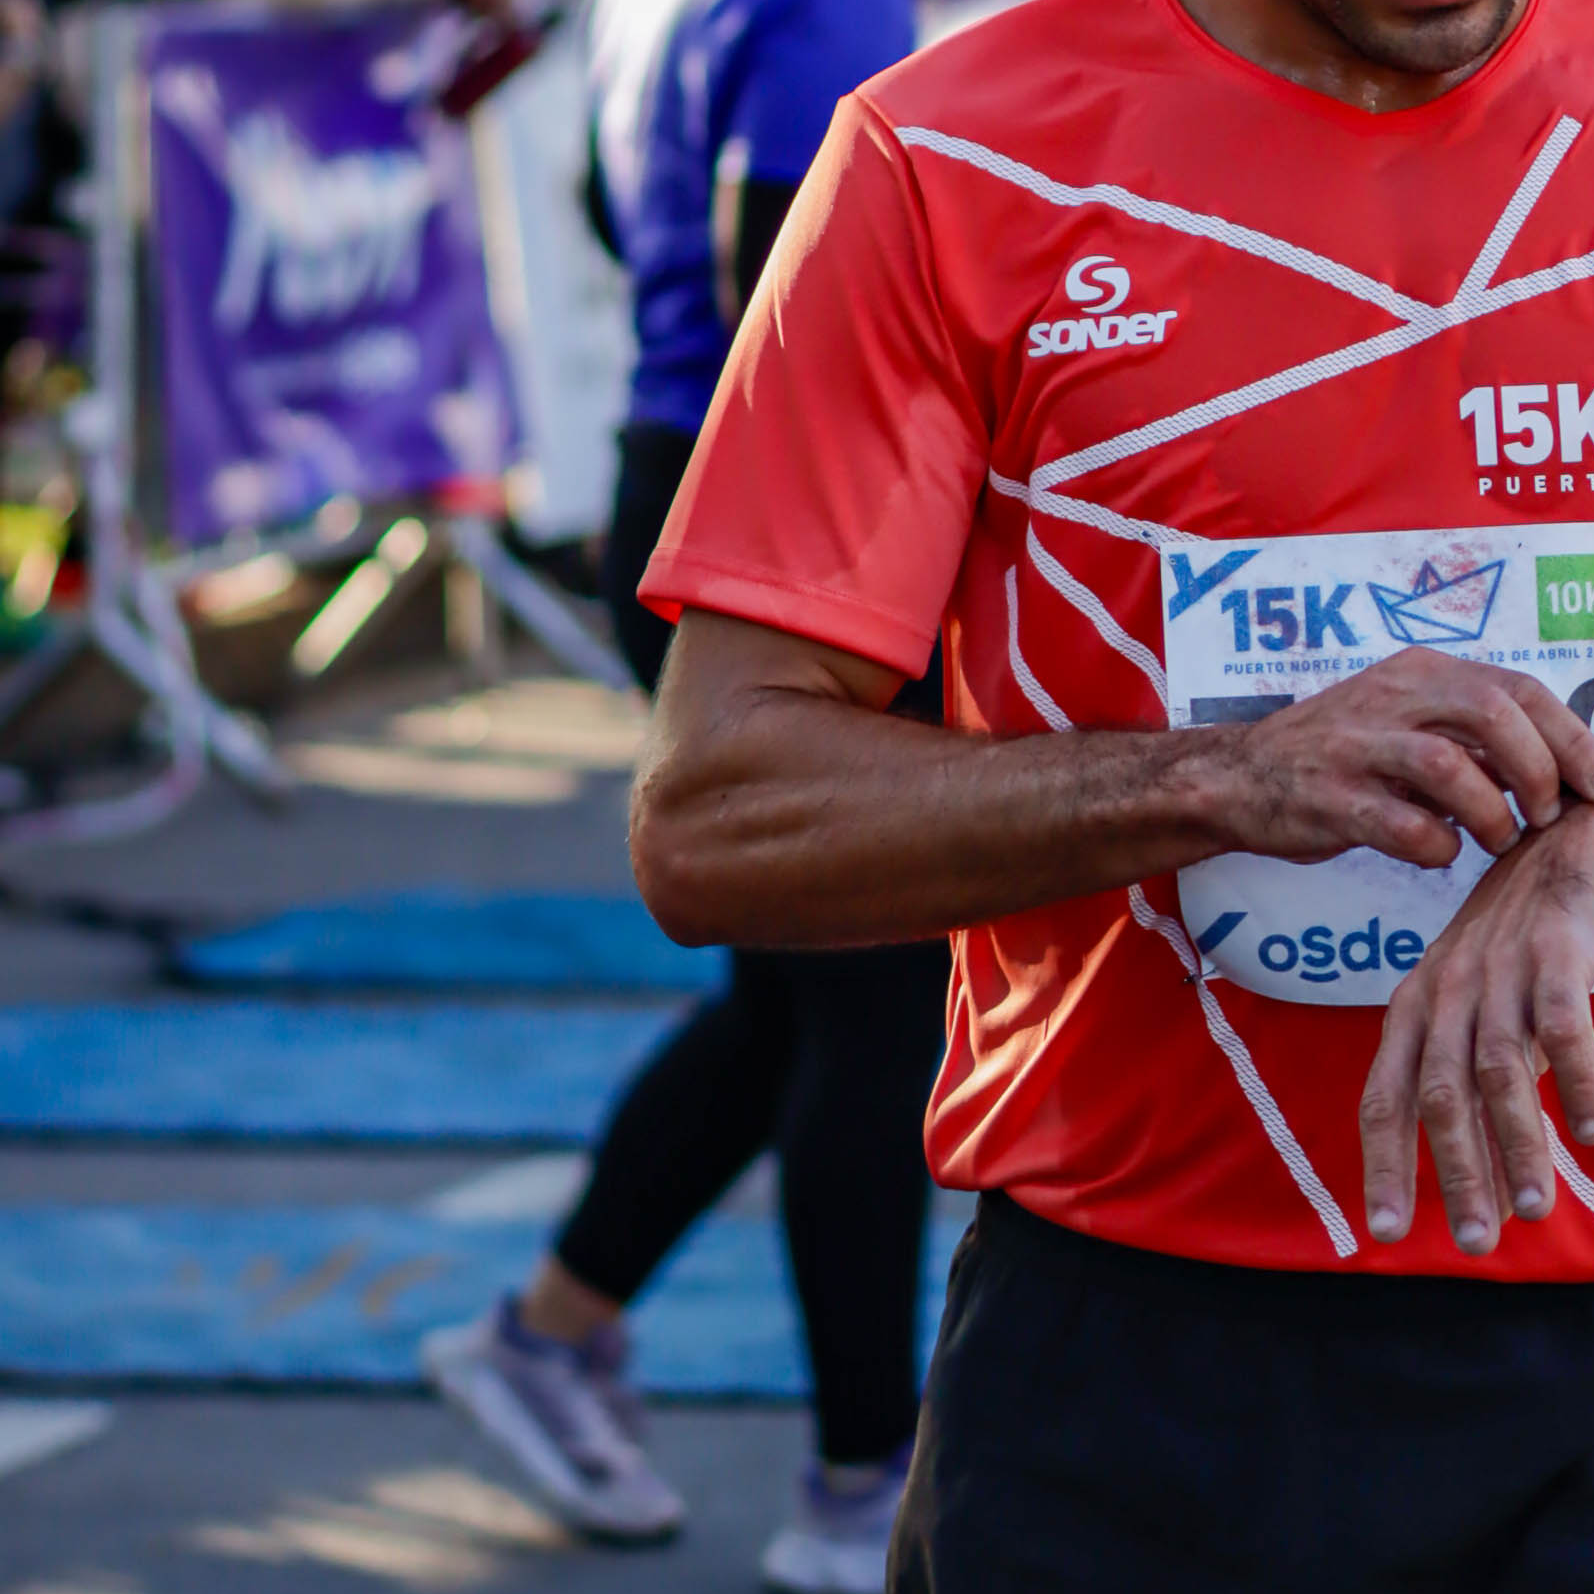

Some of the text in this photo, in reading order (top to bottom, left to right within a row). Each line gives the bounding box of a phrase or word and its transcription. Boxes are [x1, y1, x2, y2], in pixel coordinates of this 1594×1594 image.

[1220, 583, 1361, 653] 15K
[1224, 662, 1285, 675] PUERTO
[1290, 659, 1342, 673] NORTE
[1488, 651, 1505, 663] 12
[1511, 649, 1530, 661] DE
[1536, 647, 1581, 660] ABRIL
[1258, 915, 1425, 973] osde
